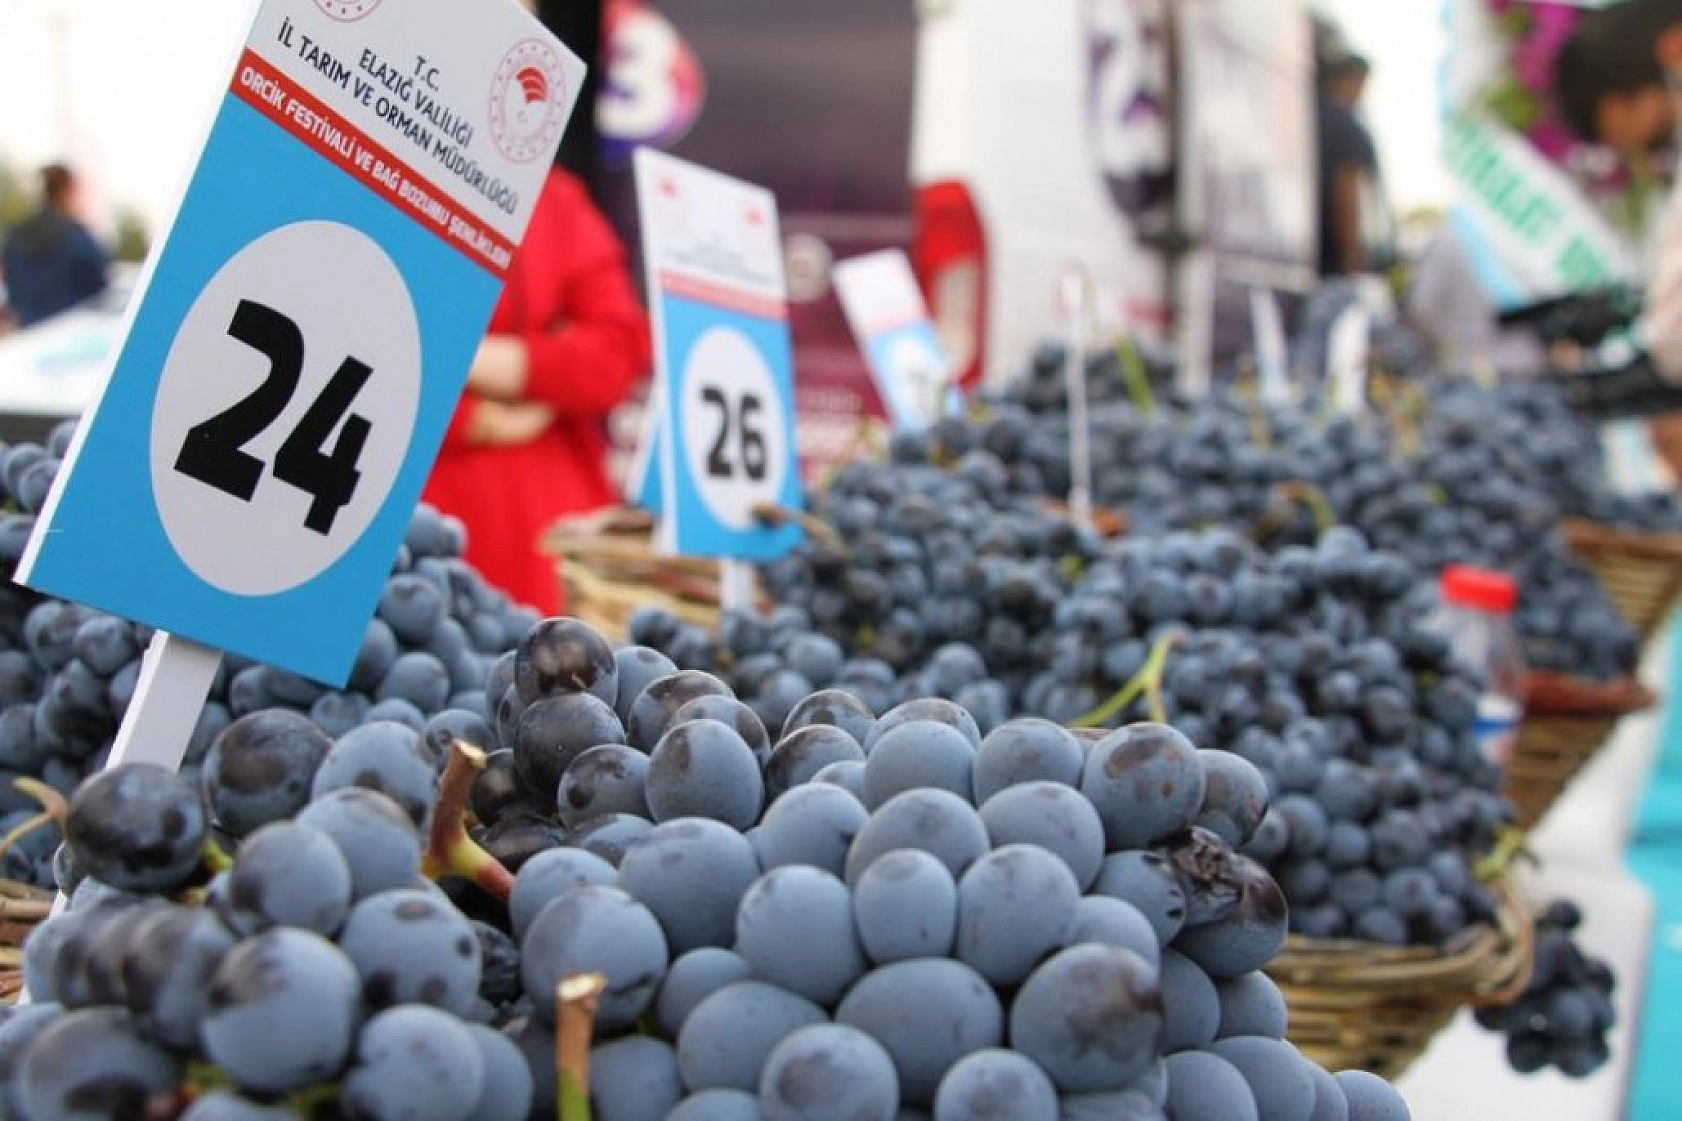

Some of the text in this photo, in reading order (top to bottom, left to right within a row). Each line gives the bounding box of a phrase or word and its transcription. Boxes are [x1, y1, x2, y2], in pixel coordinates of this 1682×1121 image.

[241, 66, 286, 111] ORCİK
[285, 98, 357, 159] FESTİVALİ
[355, 146, 374, 171] VE
[371, 159, 401, 191] BAĞ
[277, 15, 519, 215] İL TARIM VE ORMAN MÜDÜRLÜĞÜ
[358, 48, 413, 102] ELAZIĞ
[415, 55, 439, 92] T.C.
[173, 298, 374, 536] 24
[701, 386, 766, 482] 26
